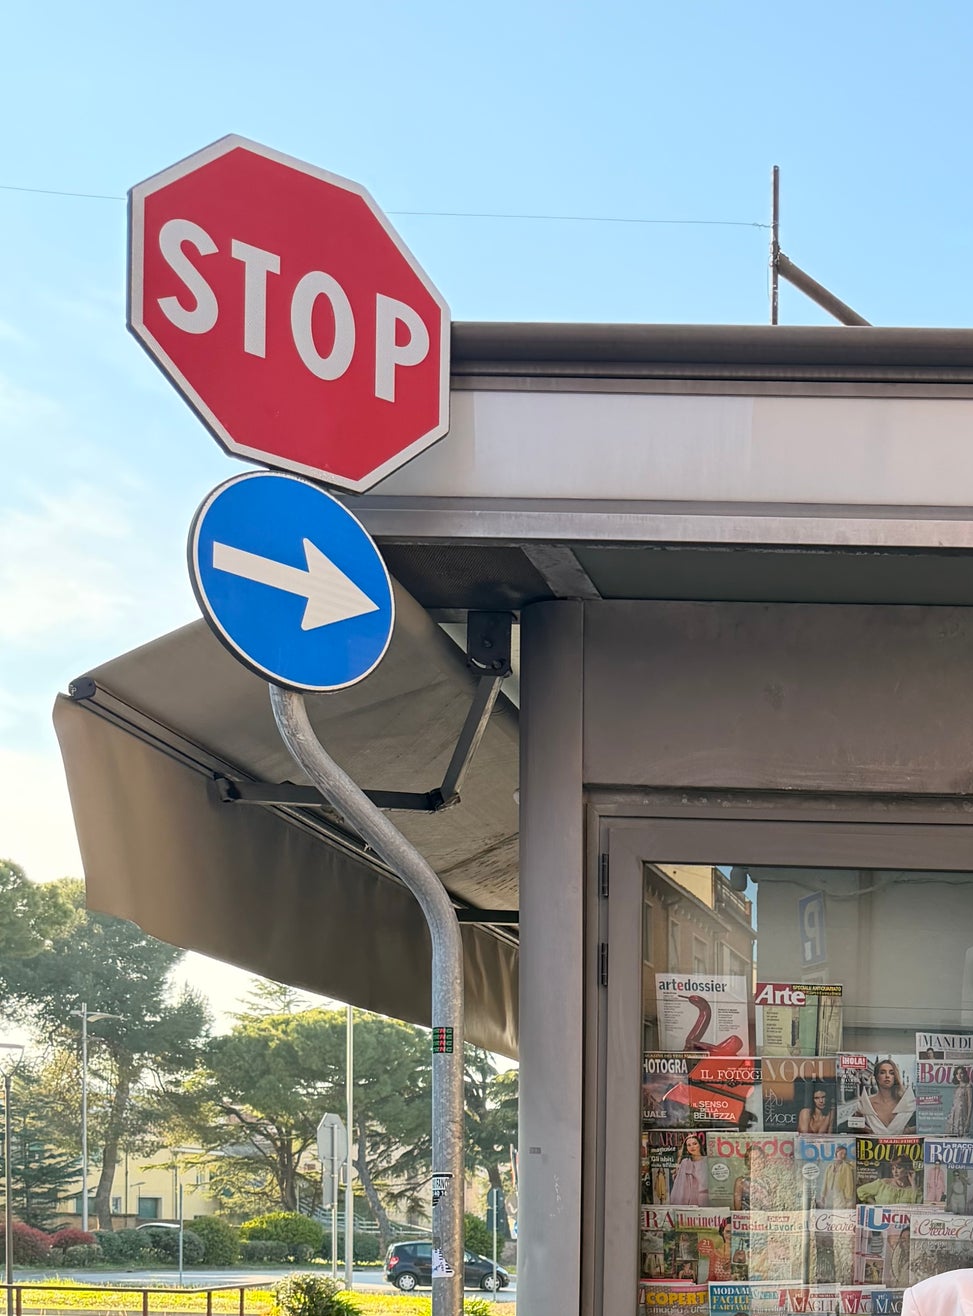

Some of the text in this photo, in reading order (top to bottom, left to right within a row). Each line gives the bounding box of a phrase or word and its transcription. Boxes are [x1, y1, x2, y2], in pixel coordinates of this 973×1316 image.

[157, 218, 430, 403] STOP
[658, 979, 727, 993] artedossier
[755, 984, 806, 1005] Arte
[701, 1070, 713, 1080] IL
[698, 1101, 728, 1109] SENSO
[693, 1111, 736, 1120] BELLEZZA
